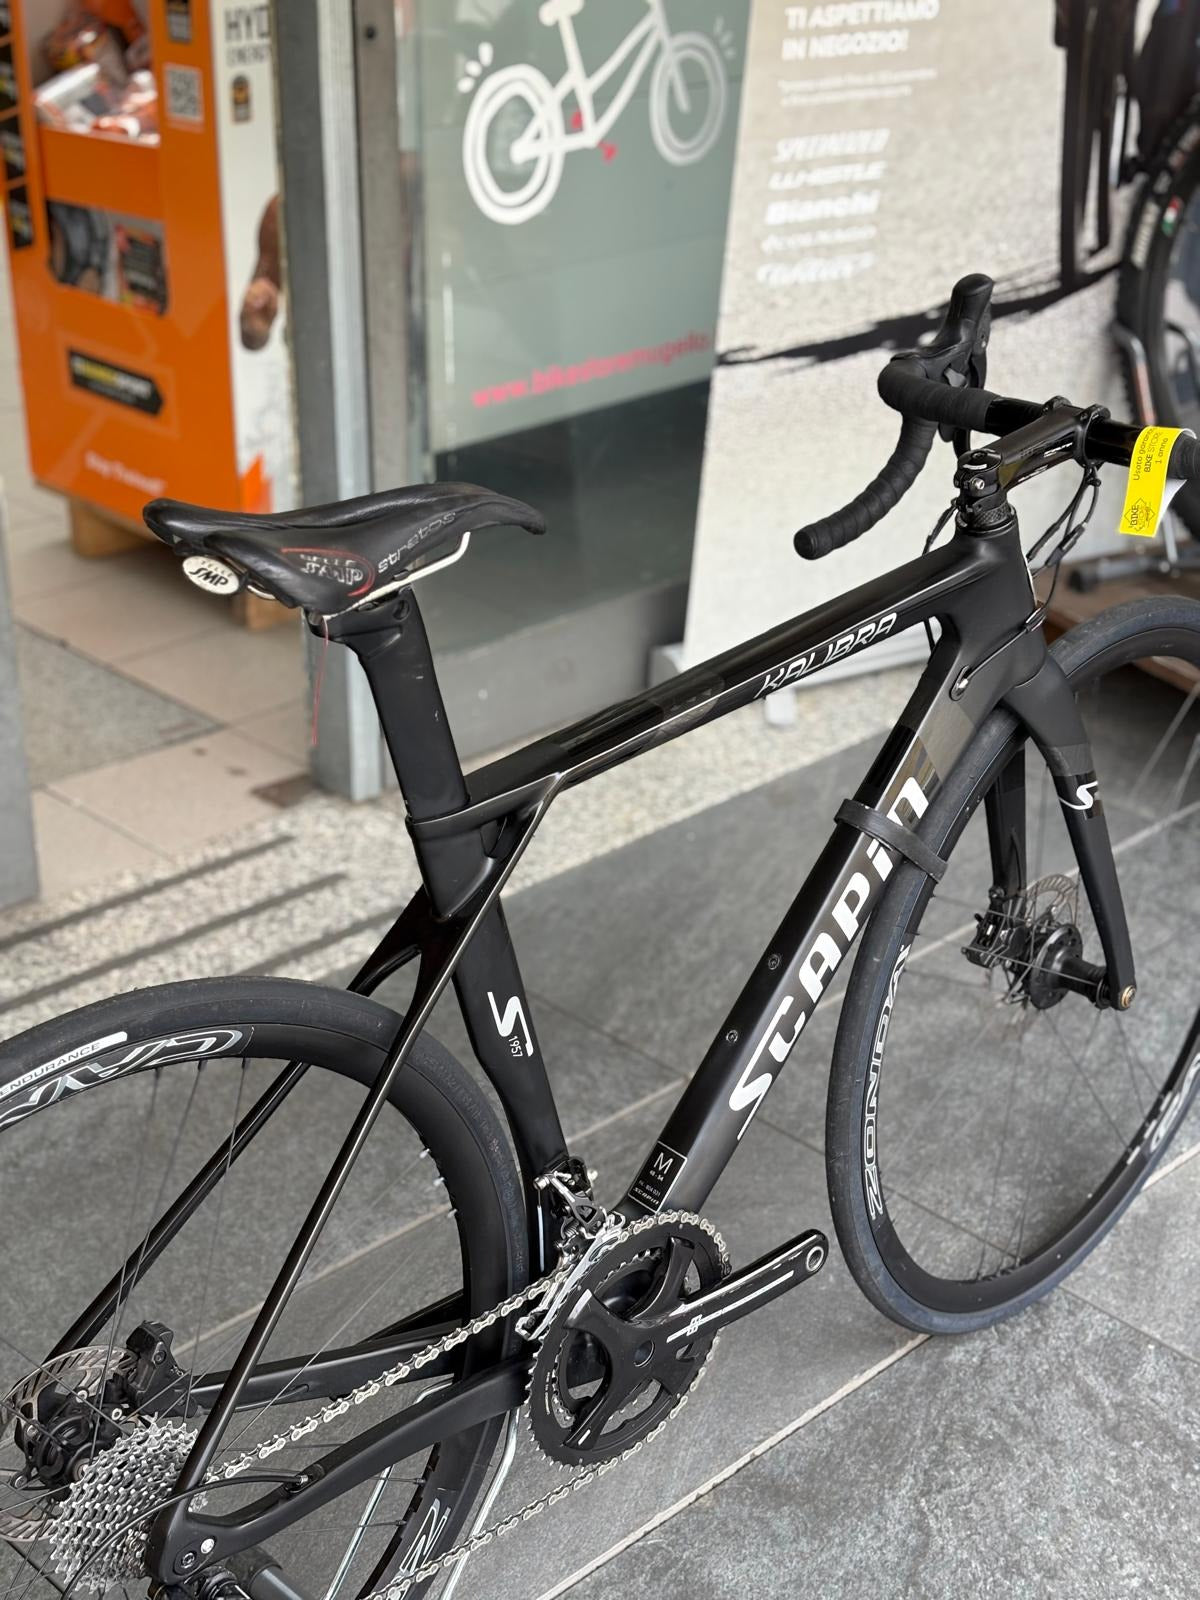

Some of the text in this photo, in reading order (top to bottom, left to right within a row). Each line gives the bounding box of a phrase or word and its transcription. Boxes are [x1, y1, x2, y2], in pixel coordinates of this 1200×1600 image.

[1144, 454, 1153, 472] BIKE
[189, 567, 229, 586] SMP
[508, 1035, 523, 1057] 1957
[0, 1042, 100, 1096] ENDURANCE
[653, 1152, 674, 1174] M
